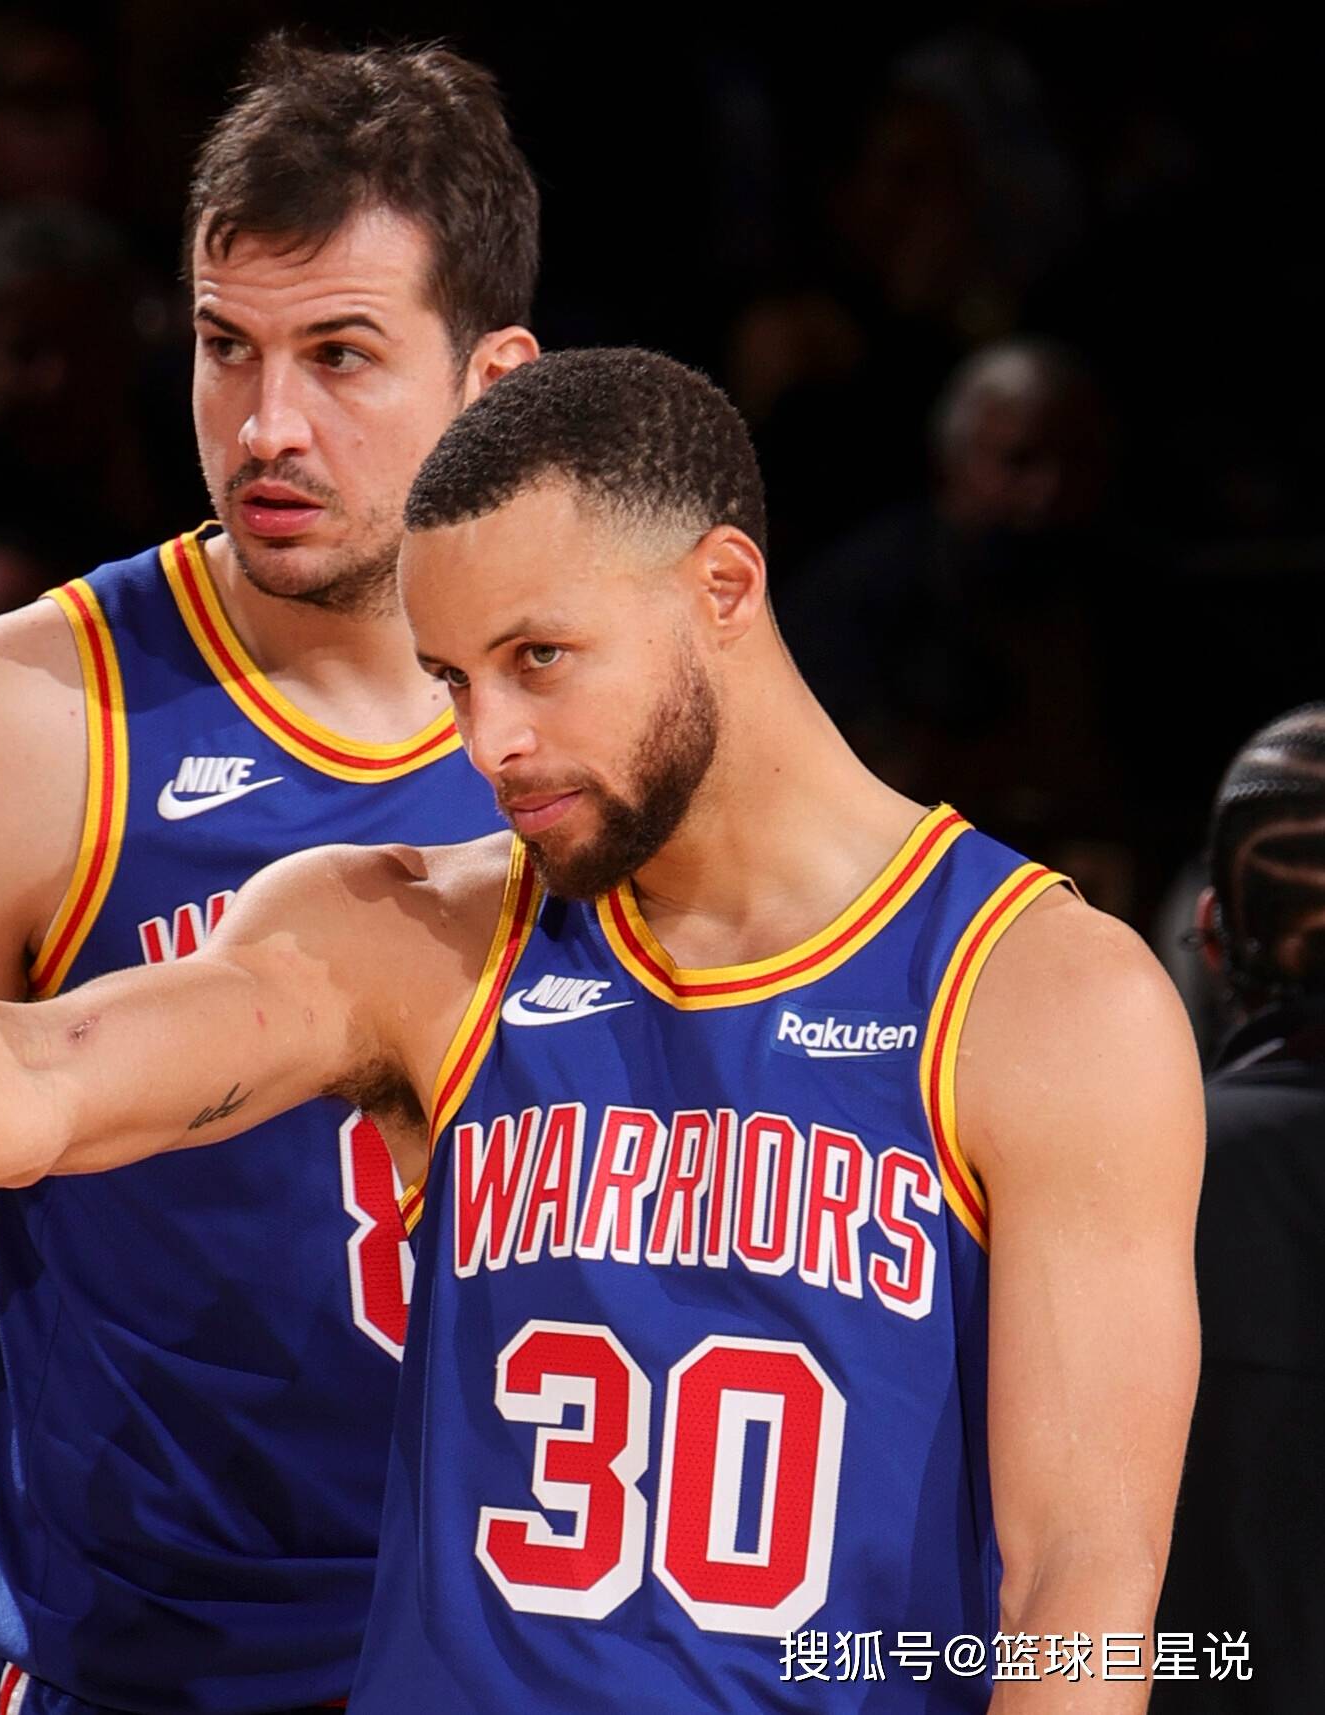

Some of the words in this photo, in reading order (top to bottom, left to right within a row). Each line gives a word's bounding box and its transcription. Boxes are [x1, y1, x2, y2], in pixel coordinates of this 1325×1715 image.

[173, 756, 256, 793] NIKE
[524, 974, 612, 1011] NIKE
[777, 1010, 917, 1053] Rakuten
[454, 1102, 942, 1320] WARRIORS
[475, 1318, 847, 1638] 30
